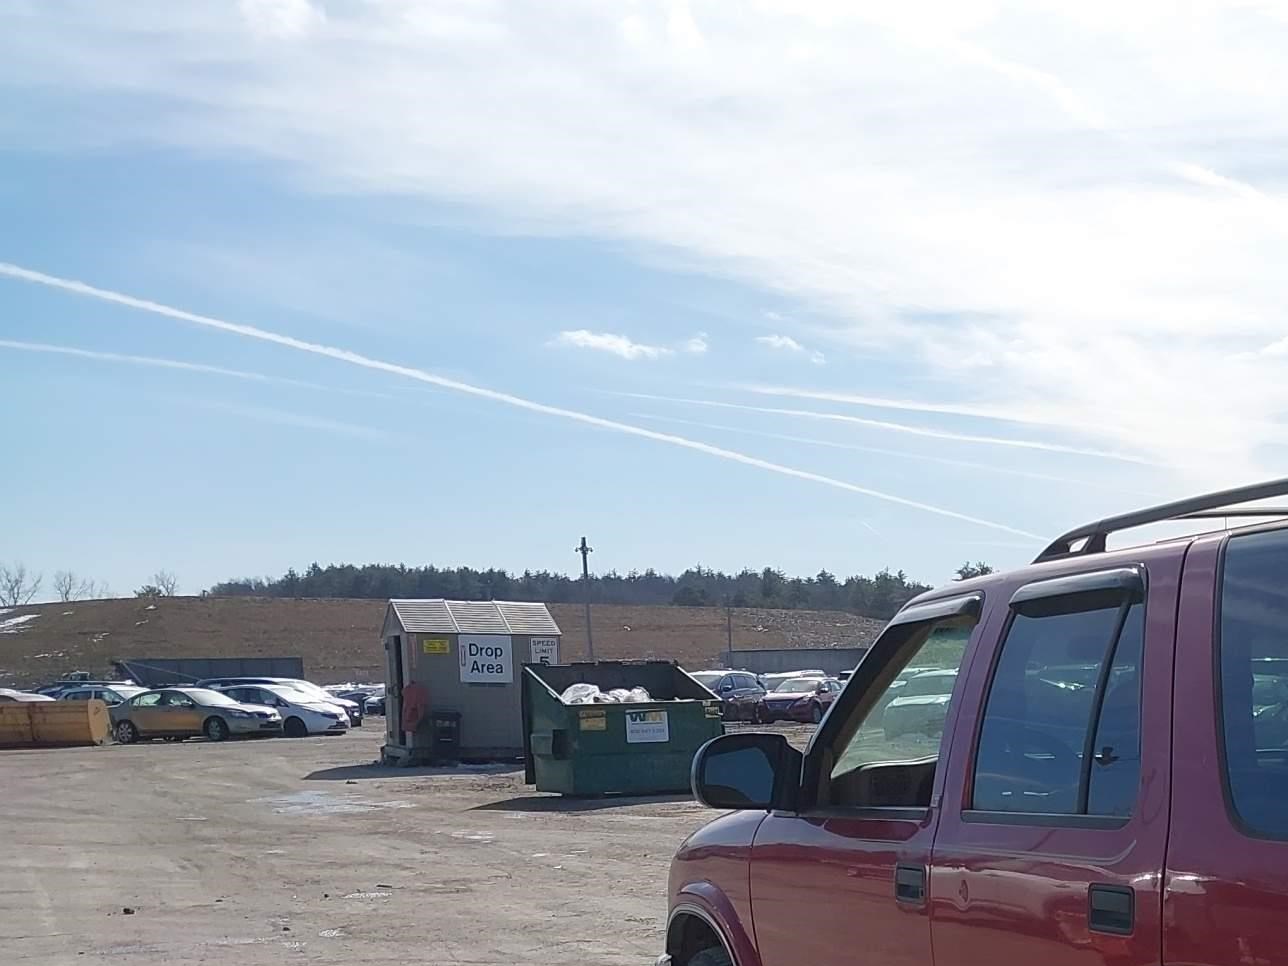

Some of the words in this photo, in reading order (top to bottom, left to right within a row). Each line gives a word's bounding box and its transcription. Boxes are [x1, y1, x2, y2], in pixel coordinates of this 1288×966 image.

[532, 639, 556, 647] SPEED
[468, 643, 503, 659] Drop
[470, 660, 504, 674] Area
